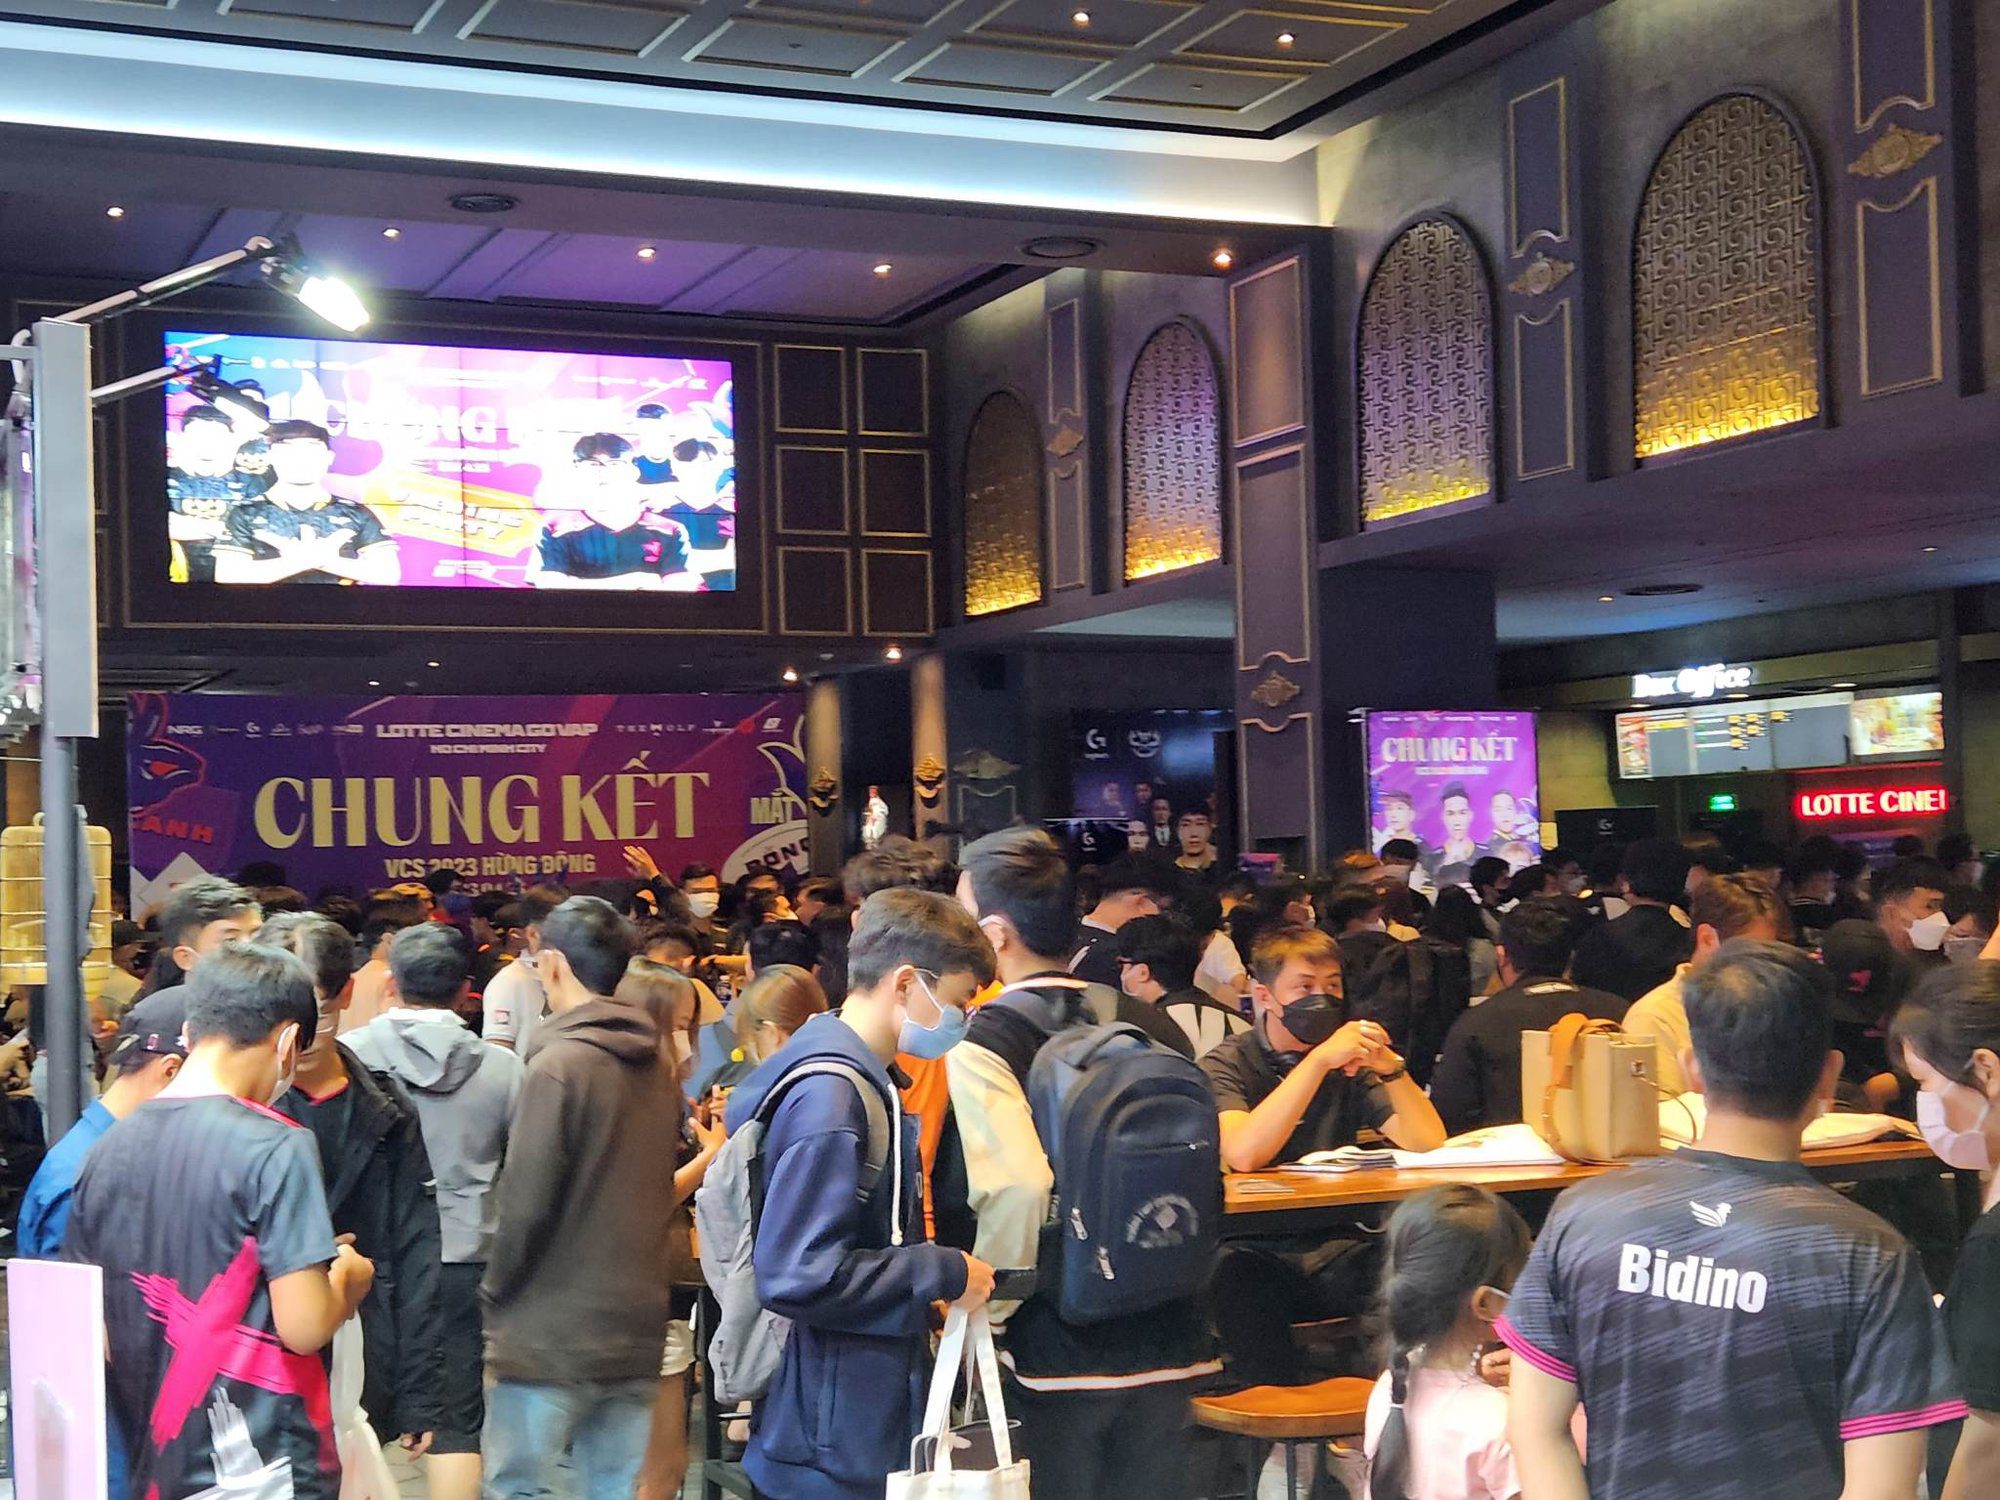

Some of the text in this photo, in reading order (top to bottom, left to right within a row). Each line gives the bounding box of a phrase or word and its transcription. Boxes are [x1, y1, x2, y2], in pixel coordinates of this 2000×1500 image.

[376, 724, 444, 738] LOTTE
[445, 723, 526, 737] CINEMA
[1382, 728, 1519, 762] CHUNG KẾT
[254, 750, 710, 849] CHUNG KẾT
[1801, 789, 1947, 817] LOTTE CINE
[384, 858, 426, 878] VCS
[1617, 1243, 1768, 1314] Bidino
